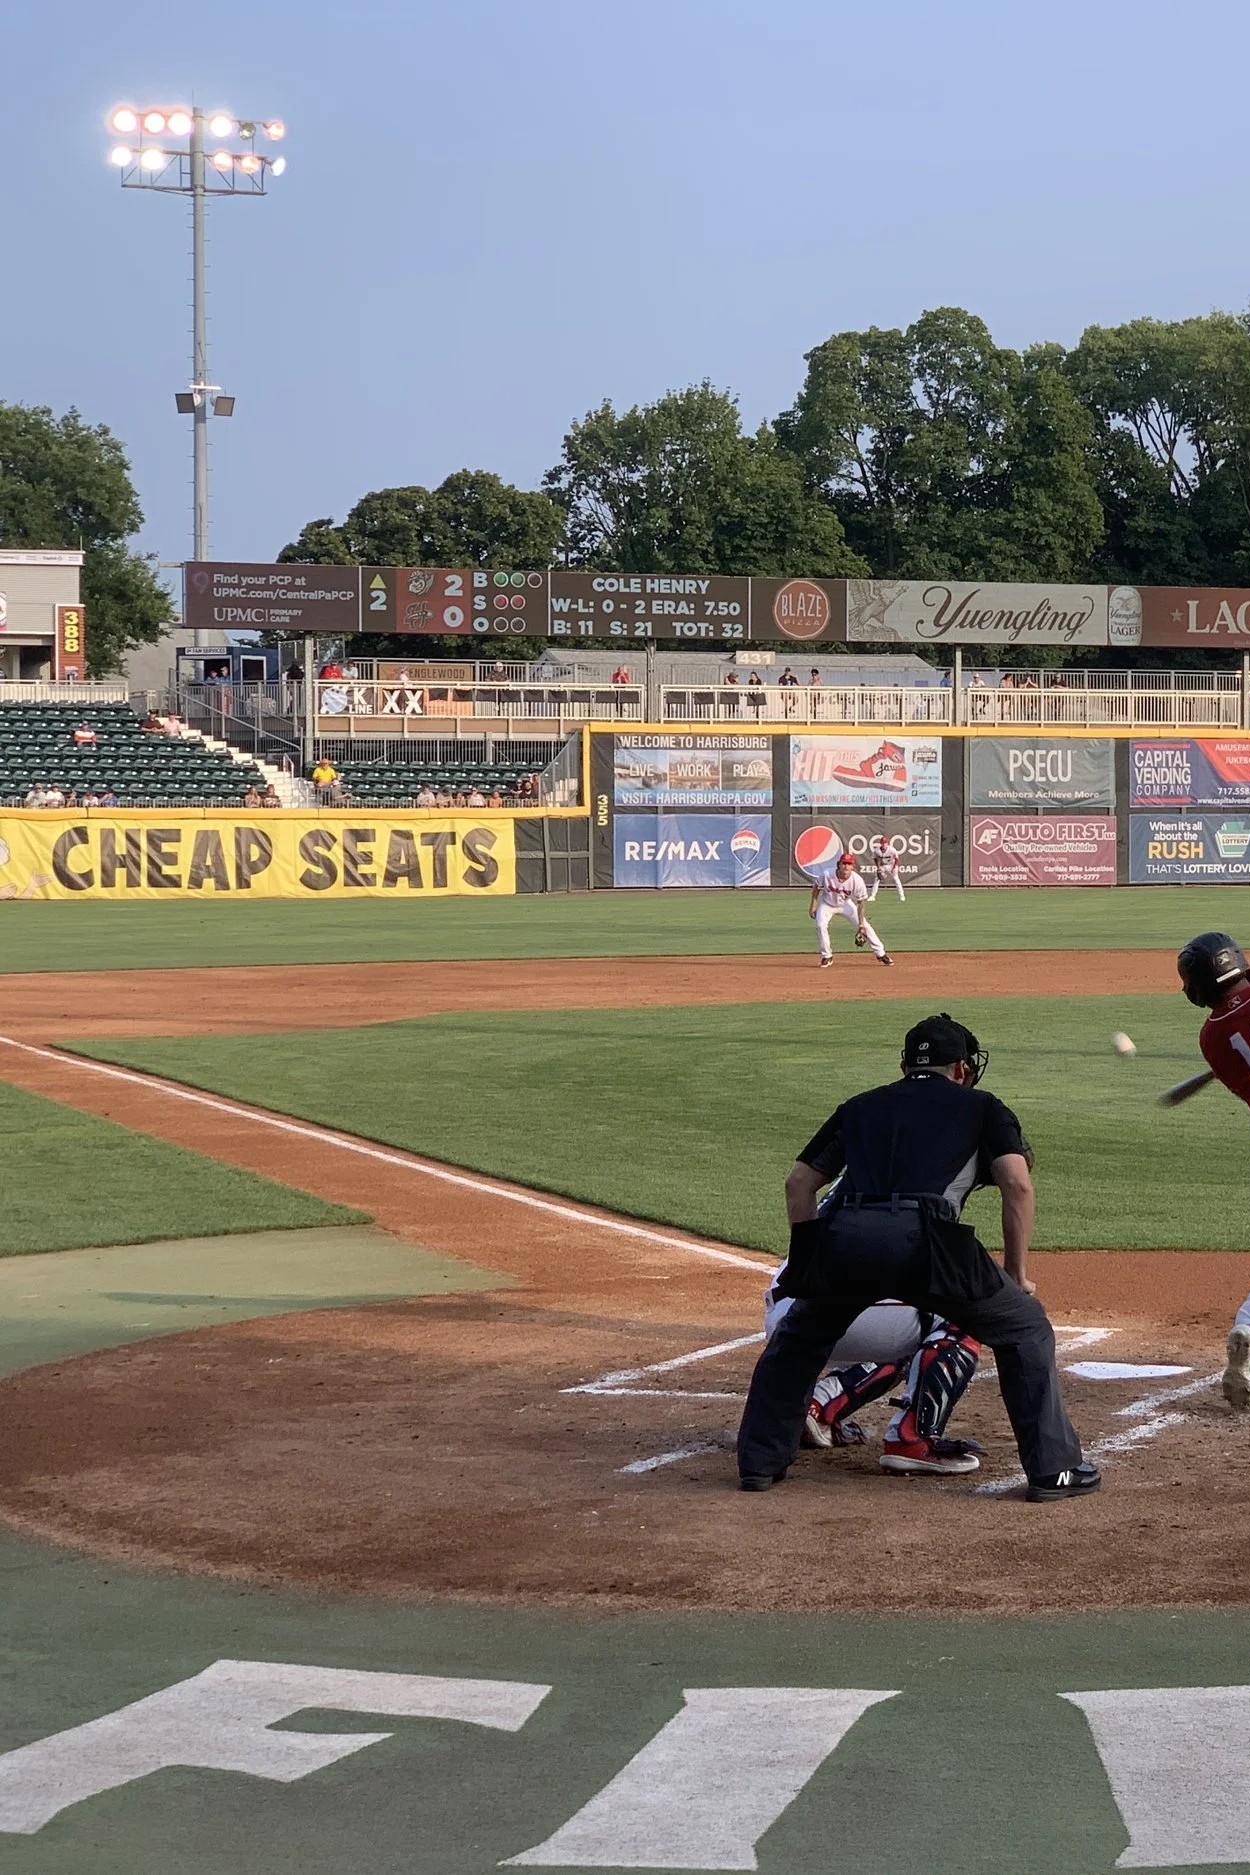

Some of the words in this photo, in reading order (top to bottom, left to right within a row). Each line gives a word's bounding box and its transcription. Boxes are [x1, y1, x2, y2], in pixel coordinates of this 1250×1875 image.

[213, 574, 238, 584] Find
[241, 576, 267, 587] your
[269, 575, 293, 586] PCP
[294, 577, 306, 586] at
[444, 574, 464, 597] 2
[473, 572, 488, 588] B
[592, 577, 641, 593] COLE
[646, 578, 710, 594] HENRY
[213, 588, 355, 601] UPMC.com/CentralPaPCP
[370, 590, 387, 611] 2
[473, 595, 487, 610] S
[551, 598, 595, 613] W-L:
[602, 600, 615, 613] 0
[634, 600, 646, 614] 2
[652, 601, 695, 615] ERA:
[704, 602, 741, 616] 7.50
[781, 592, 823, 618] BLAZE
[213, 607, 265, 622] UPMC
[443, 605, 464, 628] 0
[916, 586, 1095, 642] Yuengling
[64, 611, 79, 652] 388
[473, 617, 489, 632] O
[553, 620, 572, 635] B:
[578, 620, 593, 635] 11
[609, 621, 628, 635] S:
[634, 621, 653, 636] 21
[672, 622, 714, 637] TOT:
[721, 623, 744, 638] 32
[1110, 624, 1140, 636] LAGER
[739, 653, 771, 665] 431
[408, 668, 465, 679] ENGLEWOOD
[353, 687, 368, 705] K
[349, 704, 372, 715] LINE
[620, 735, 675, 748] WELCOME
[679, 736, 693, 748] TO
[696, 736, 768, 749] HARRISBURG
[841, 751, 861, 762] THIS
[1135, 751, 1191, 767] CAPITAL
[629, 764, 654, 777] LIVE
[677, 764, 711, 777] WORK
[733, 764, 759, 777] PLAY
[793, 751, 838, 782] HIT
[1009, 749, 1072, 783] PSECU
[1135, 768, 1191, 784] VENDING
[988, 790, 1033, 798] Members
[1035, 790, 1072, 798] Achieve
[1075, 790, 1099, 798] More
[1136, 785, 1191, 795] COMPANY
[622, 793, 652, 804] VISIT:
[655, 793, 766, 804] HARRISBURGPA.GOV
[597, 794, 609, 826] 355
[1003, 823, 1055, 840] AUTO
[1057, 823, 1107, 840] FIRST
[1149, 821, 1178, 831] When
[1178, 821, 1191, 831] it's
[1192, 821, 1202, 831] all
[978, 829, 999, 844] AF
[1154, 832, 1182, 841] about
[1183, 832, 1198, 840] the
[625, 841, 720, 861] RE/MAX
[1003, 844, 1029, 854] Quality
[1030, 843, 1068, 852] Pre-owned
[1069, 843, 1097, 852] Vehicles
[1148, 842, 1204, 859] RUSH
[51, 826, 273, 891] CHEAP
[298, 827, 499, 890] SEATS
[1146, 864, 1181, 874] THAT'S
[1183, 864, 1226, 873] LOTTERY
[1056, 1470, 1070, 1486] N
